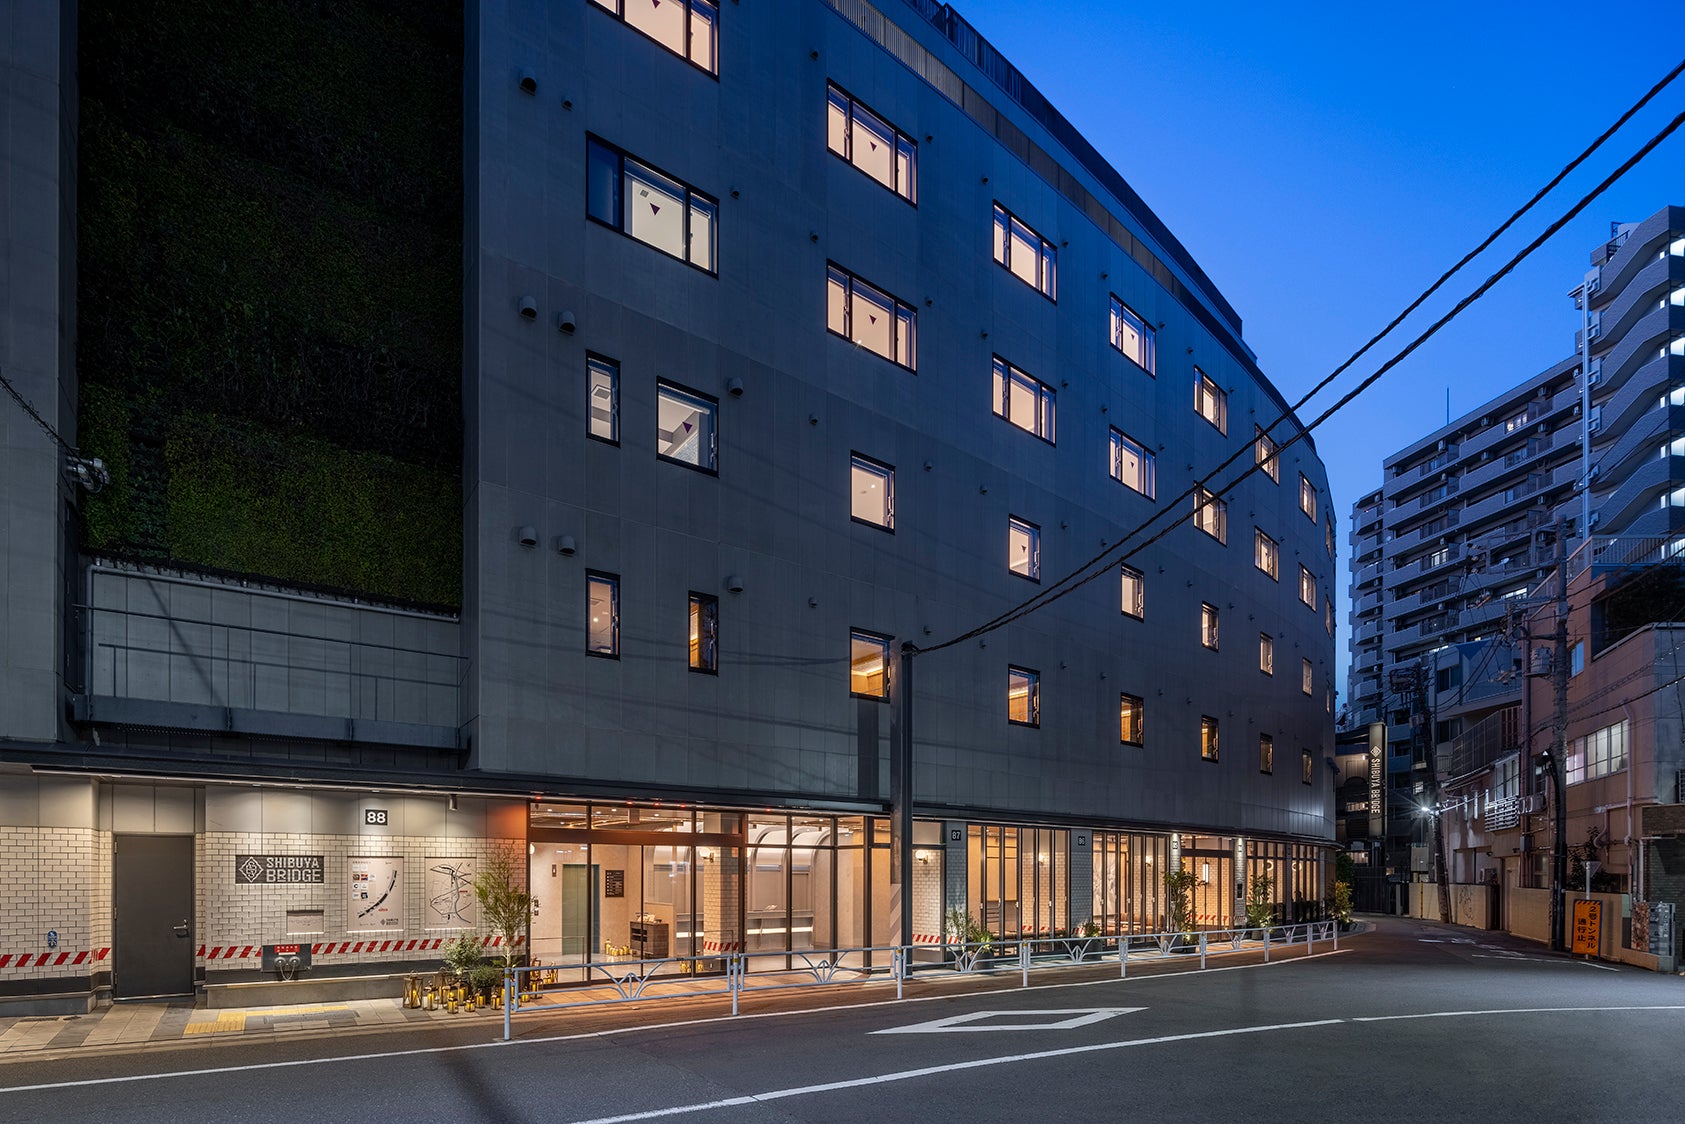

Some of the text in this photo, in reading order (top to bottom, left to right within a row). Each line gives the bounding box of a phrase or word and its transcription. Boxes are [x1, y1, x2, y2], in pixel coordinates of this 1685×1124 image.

[1371, 758, 1381, 814] SHIBUYA BRIDGE
[367, 811, 387, 824] 88
[951, 831, 961, 840] 87
[266, 857, 320, 868] SHIBUYA
[266, 869, 322, 883] BRIDGE
[1577, 918, 1587, 942] 通行止
